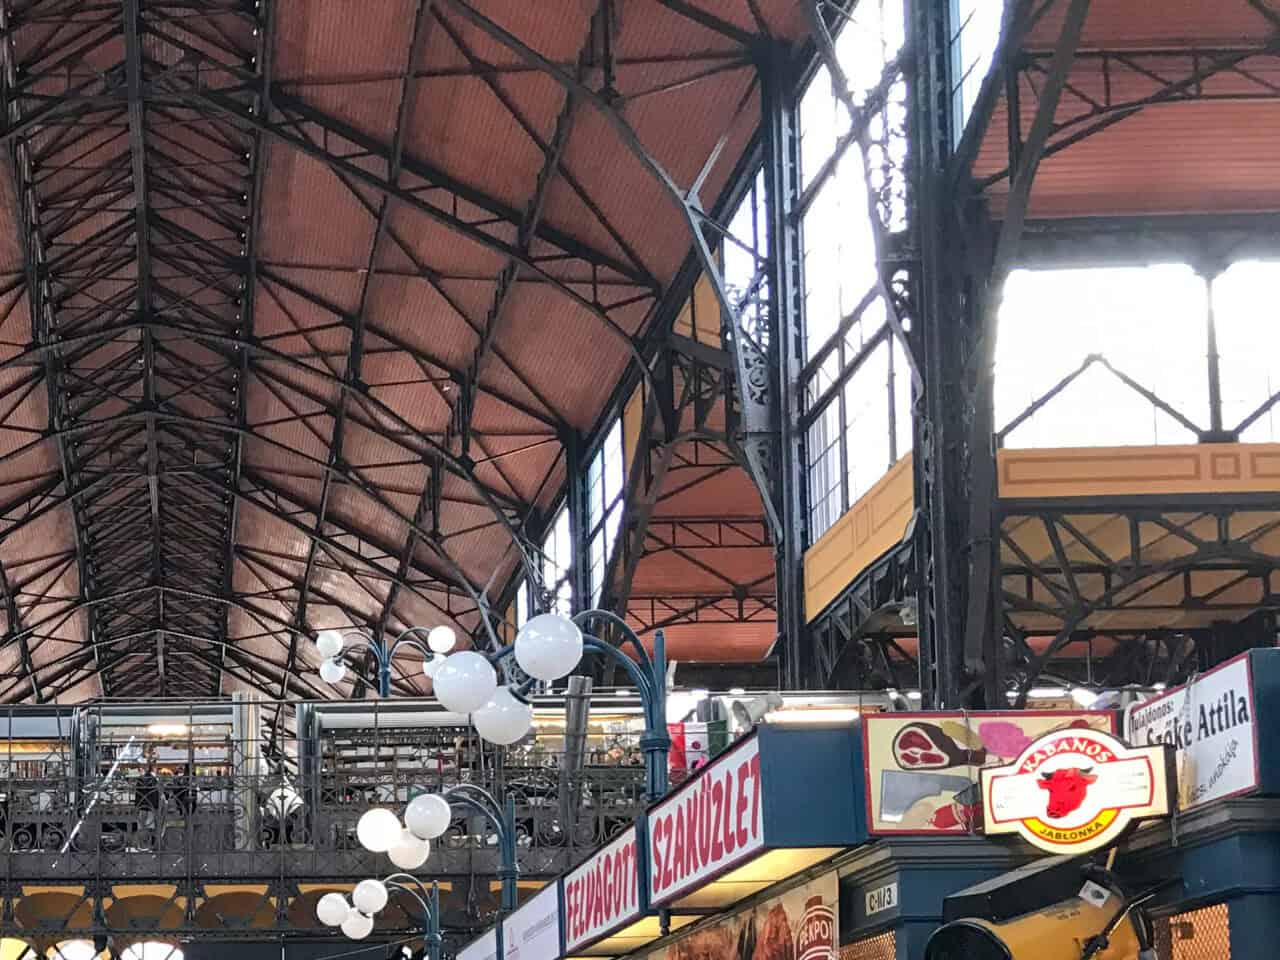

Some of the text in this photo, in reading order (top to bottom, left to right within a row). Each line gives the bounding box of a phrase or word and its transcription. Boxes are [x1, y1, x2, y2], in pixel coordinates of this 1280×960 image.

[1197, 689, 1249, 741] Attila
[1023, 739, 1112, 772] KABANOS
[651, 754, 761, 894] SZAKÜZLET
[566, 841, 637, 943] FELVÁGOTT
